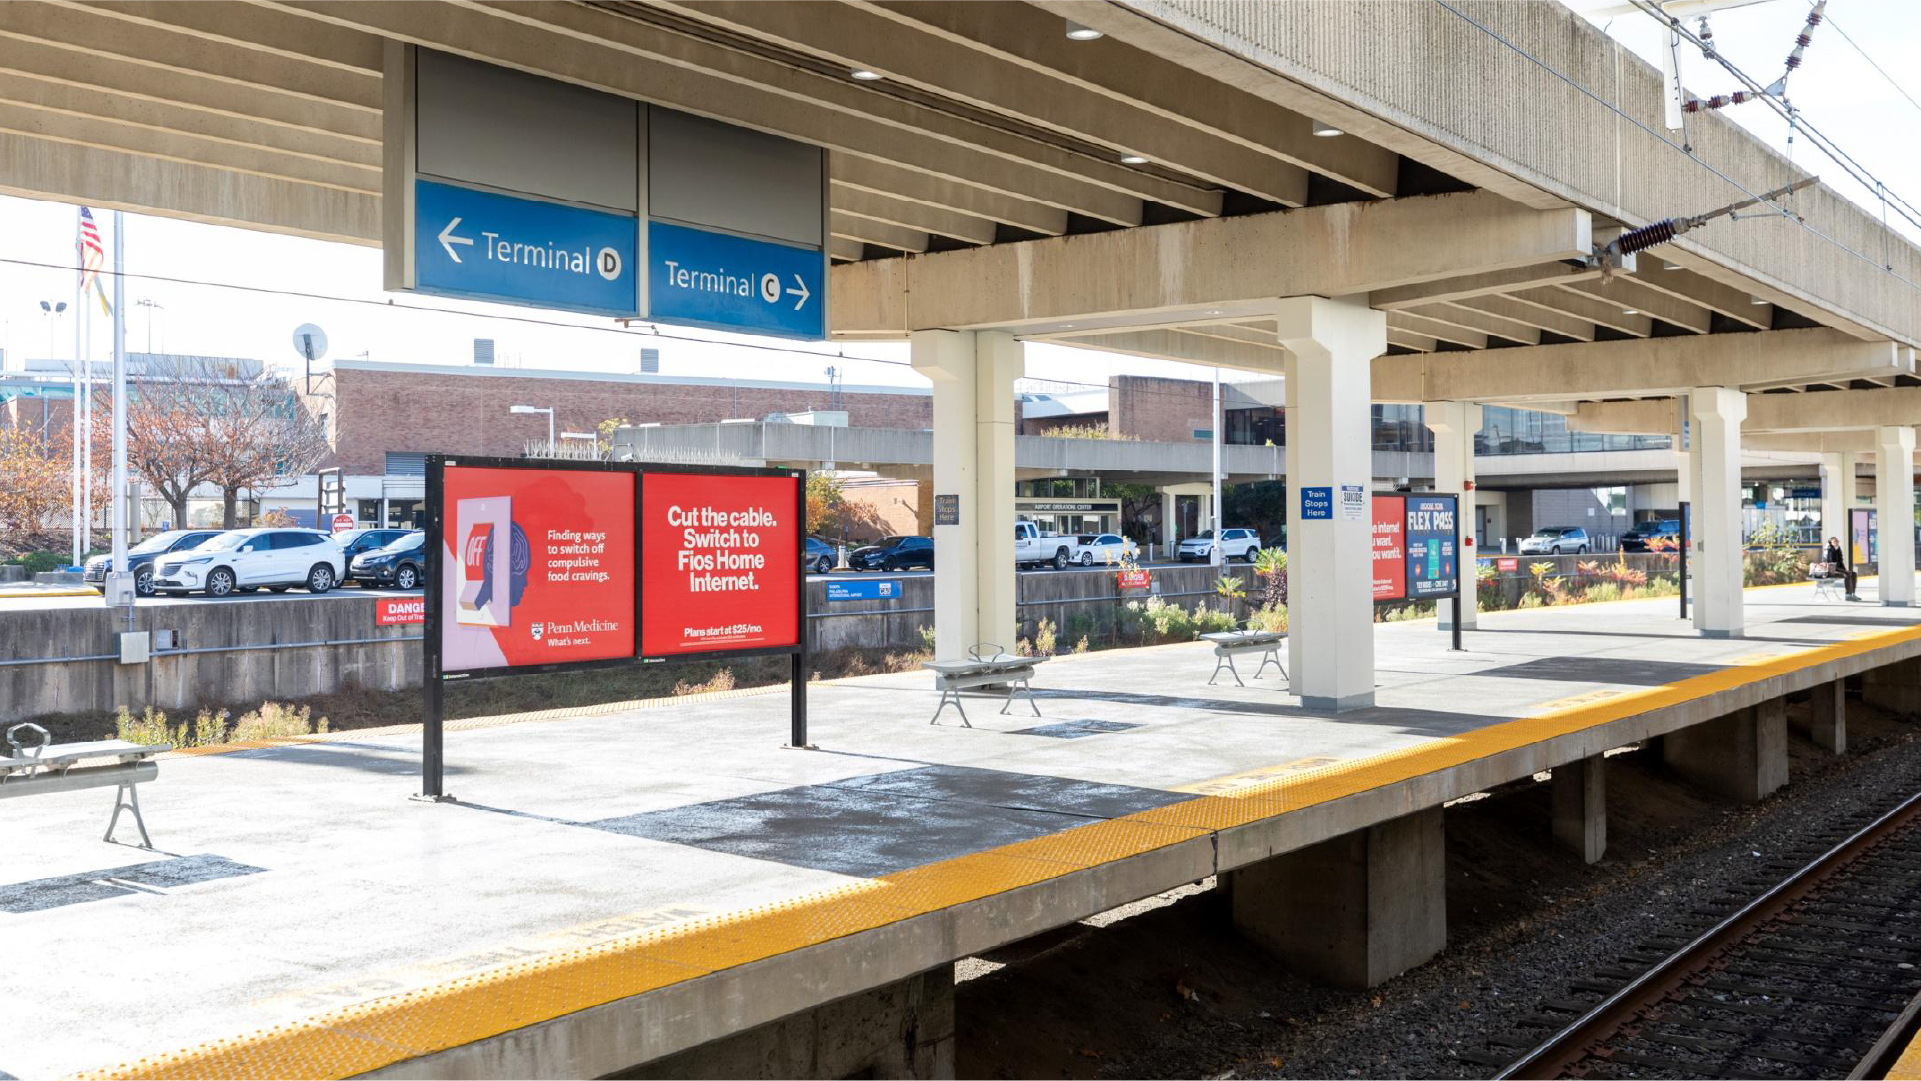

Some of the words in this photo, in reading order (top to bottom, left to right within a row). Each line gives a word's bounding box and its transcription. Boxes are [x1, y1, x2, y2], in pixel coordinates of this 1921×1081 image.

[482, 231, 590, 274] Terminal
[604, 253, 616, 273] D
[665, 260, 754, 298] Terminal
[1307, 490, 1326, 498] Train
[1304, 499, 1328, 509] Stops
[667, 505, 699, 527] Cut
[701, 506, 728, 527] the
[729, 506, 777, 527] cable.
[1307, 509, 1326, 517] Here
[1378, 521, 1400, 534] internet
[1408, 511, 1431, 530] FLEX
[1433, 511, 1454, 530] PASS
[547, 529, 582, 543] Finding
[583, 532, 606, 543] ways
[683, 528, 741, 548] Switch
[743, 529, 760, 547] to
[467, 536, 488, 567] OFF
[547, 545, 558, 554] to
[560, 543, 590, 554] switch
[591, 543, 605, 554] off
[547, 556, 599, 570] compulsive
[678, 550, 714, 571] Fios
[716, 549, 765, 570] Home
[547, 570, 570, 581] food
[571, 570, 610, 582] cravings.
[690, 571, 759, 592] Internet.
[408, 613, 414, 621] of
[547, 622, 573, 634] Penn
[574, 619, 619, 632] Medicine
[684, 627, 706, 637] Plans
[706, 625, 723, 636] start
[724, 625, 732, 635] at
[732, 623, 763, 634] $25/mo.
[547, 636, 571, 647] What's
[573, 637, 592, 645] next.
